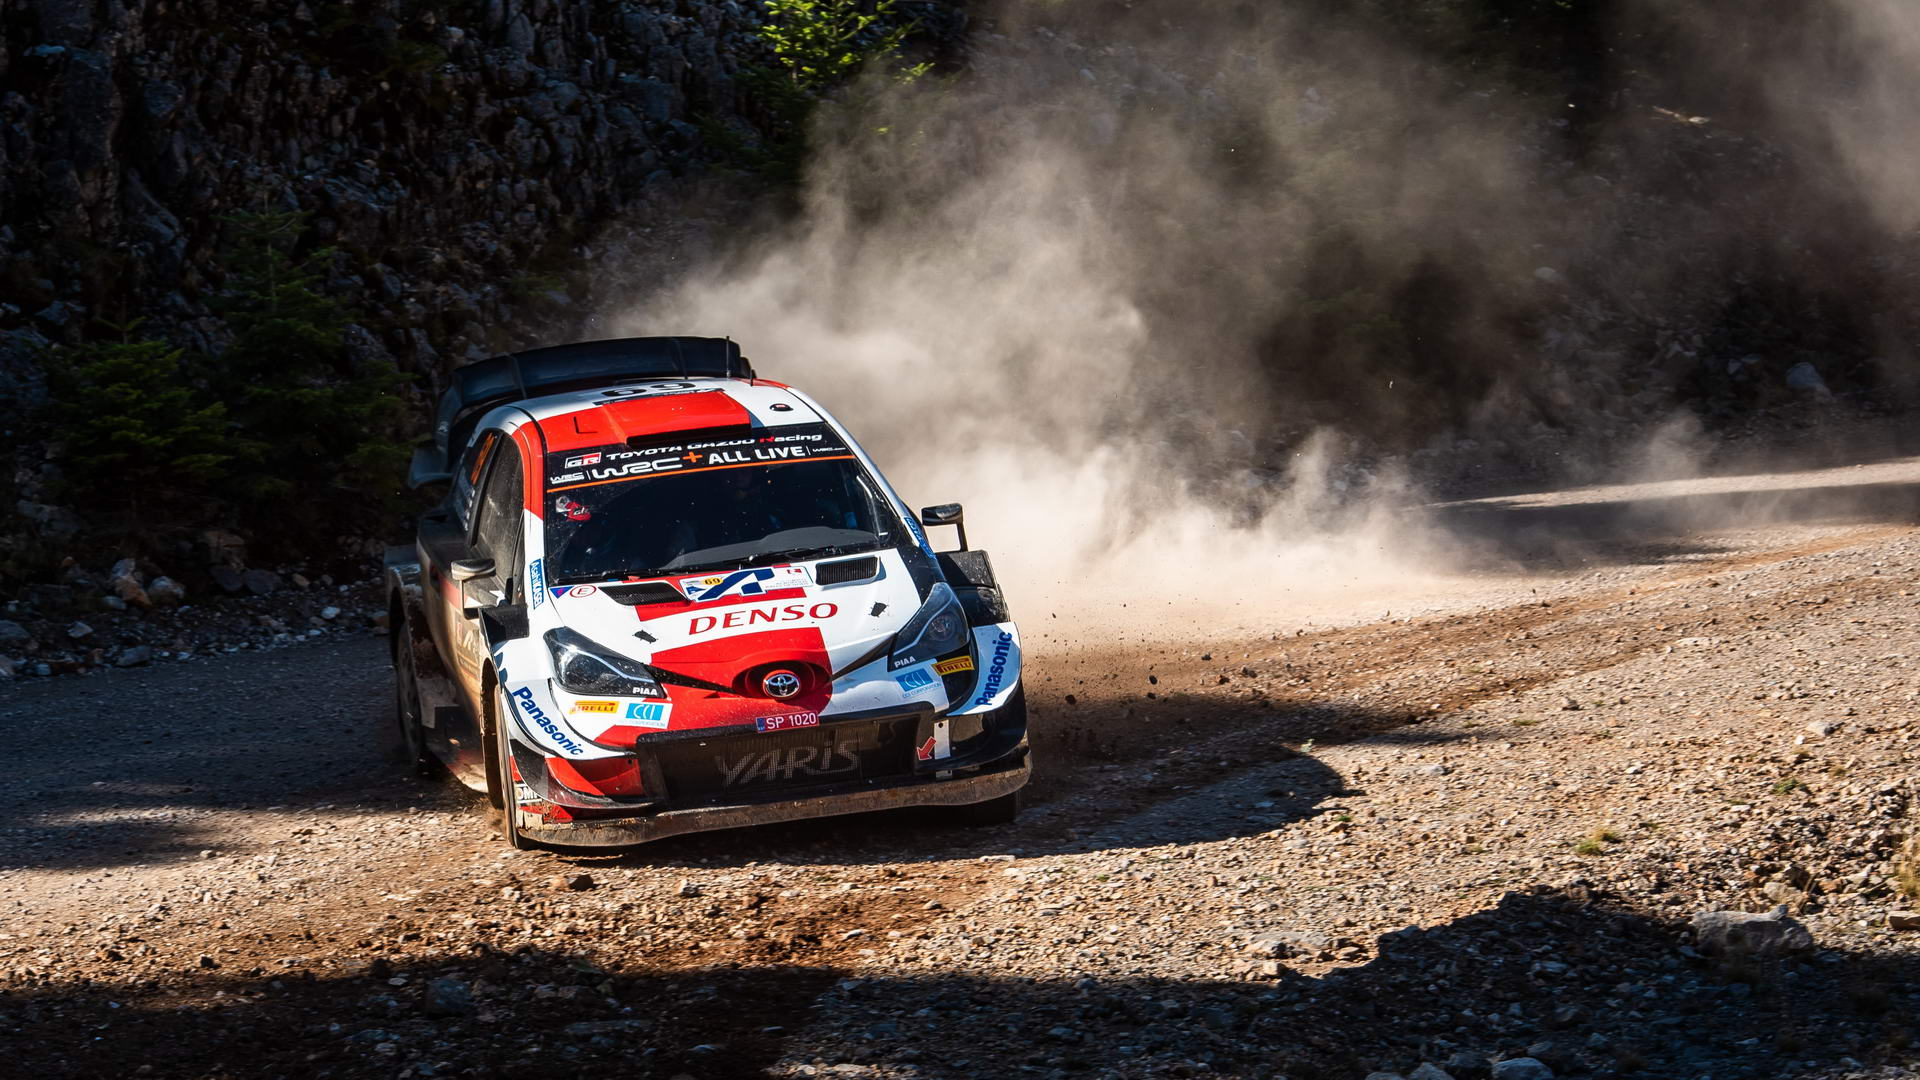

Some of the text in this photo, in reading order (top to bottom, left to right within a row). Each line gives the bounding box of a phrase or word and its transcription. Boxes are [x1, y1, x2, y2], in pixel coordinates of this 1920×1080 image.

[567, 455, 599, 467] GR
[606, 445, 682, 460] TOYOTA
[759, 434, 822, 443] Racing
[708, 450, 751, 464] ALL
[754, 446, 805, 459] LIVE
[689, 603, 838, 635] DENSO
[894, 656, 916, 668] PIAA
[936, 659, 971, 674] PIRELLI
[975, 631, 1012, 705] Panasonic
[633, 686, 658, 696] PIAA
[512, 686, 584, 756] Panasonic
[766, 712, 817, 730] SP 1020
